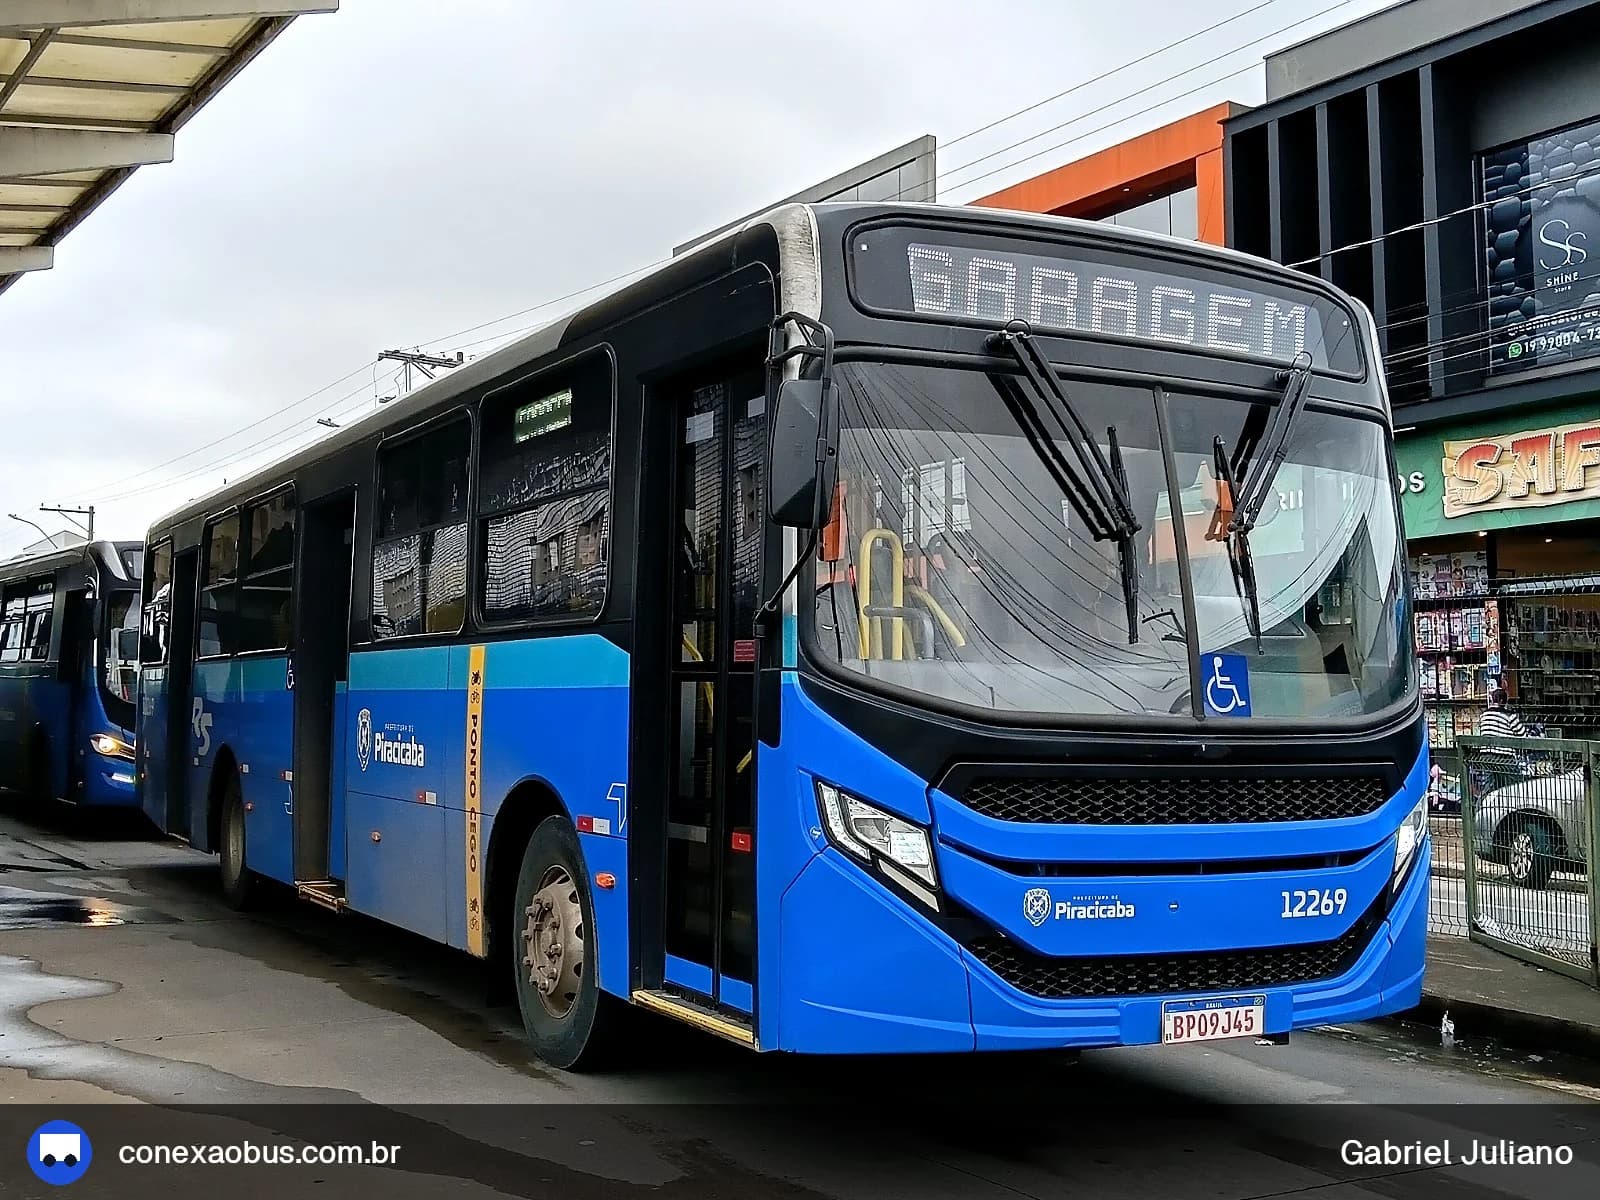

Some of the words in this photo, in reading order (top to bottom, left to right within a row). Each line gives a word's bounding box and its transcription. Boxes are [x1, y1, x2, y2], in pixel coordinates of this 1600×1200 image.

[374, 732, 425, 767] Piracicaba
[469, 714, 478, 799] PONTO
[469, 806, 478, 872] CEGO
[1055, 900, 1135, 920] Piracicaba
[1281, 888, 1347, 918] 12269
